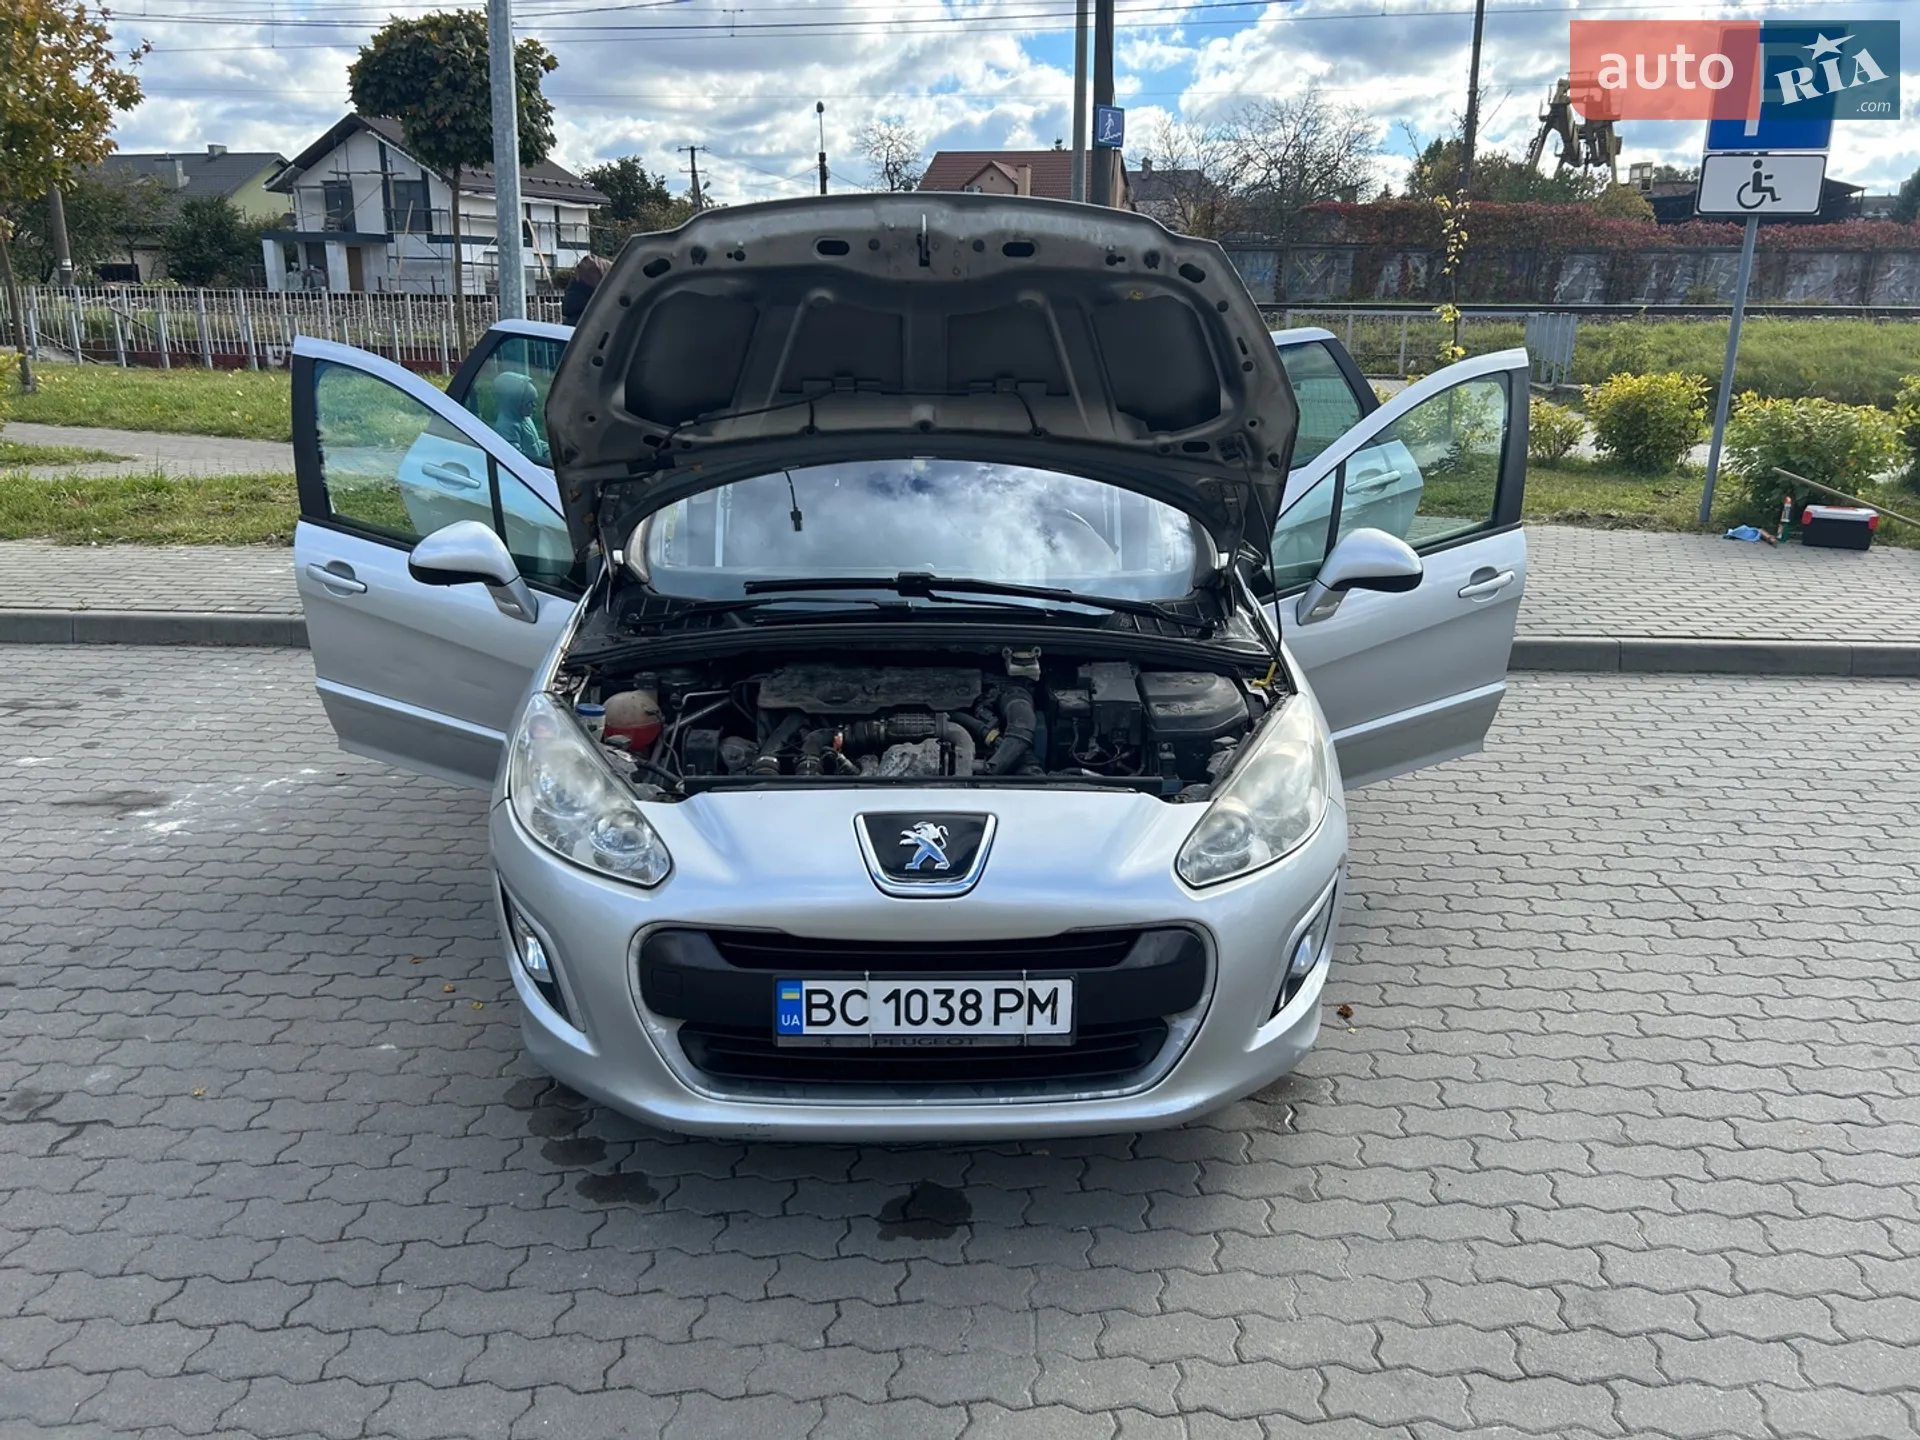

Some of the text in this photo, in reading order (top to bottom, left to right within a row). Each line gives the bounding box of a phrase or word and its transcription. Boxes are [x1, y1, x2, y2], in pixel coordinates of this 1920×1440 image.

[1744, 42, 1818, 136] P
[804, 987, 1059, 1027] BC 1038 PM
[781, 1014, 800, 1027] UA
[874, 1036, 979, 1047] PEUGEOT
